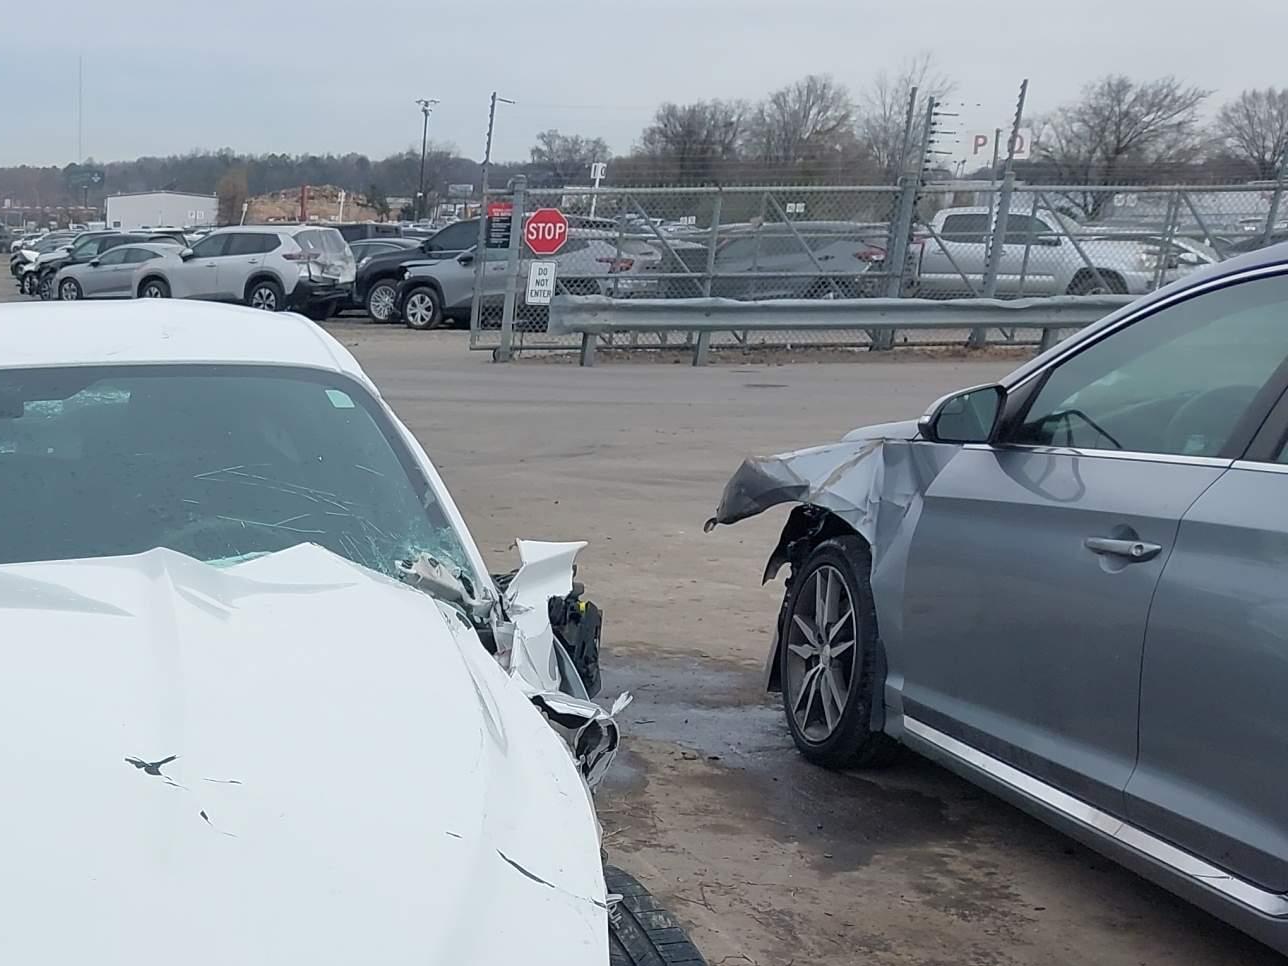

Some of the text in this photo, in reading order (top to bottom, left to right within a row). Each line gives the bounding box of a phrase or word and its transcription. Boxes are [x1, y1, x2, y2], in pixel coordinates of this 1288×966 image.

[973, 135, 988, 155] P
[528, 223, 566, 240] STOP
[538, 267, 548, 276] DO
[535, 278, 549, 287] NOT
[530, 289, 552, 298] ENTER
